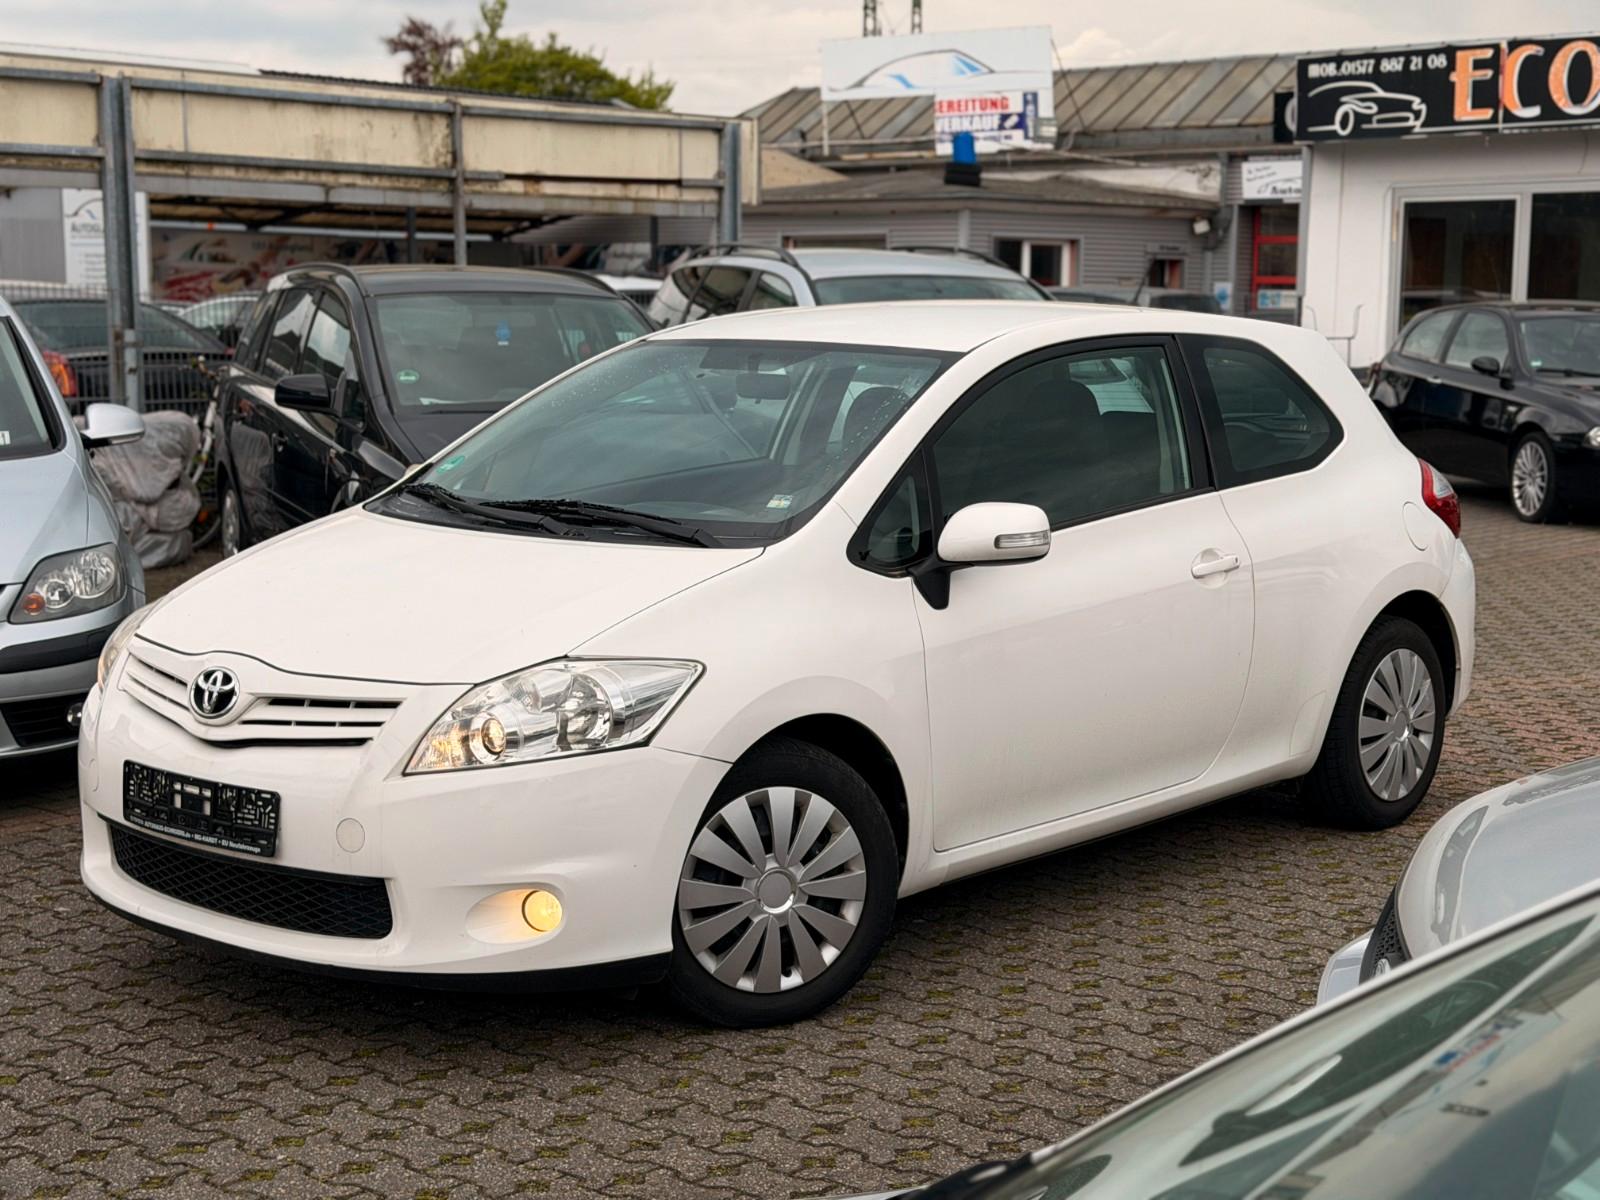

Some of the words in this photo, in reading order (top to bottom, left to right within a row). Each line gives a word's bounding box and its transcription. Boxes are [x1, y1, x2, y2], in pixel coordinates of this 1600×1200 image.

[1379, 56, 1405, 73] 887
[1409, 55, 1422, 70] 21
[1427, 53, 1447, 69] 08
[1449, 39, 1600, 122] ECO
